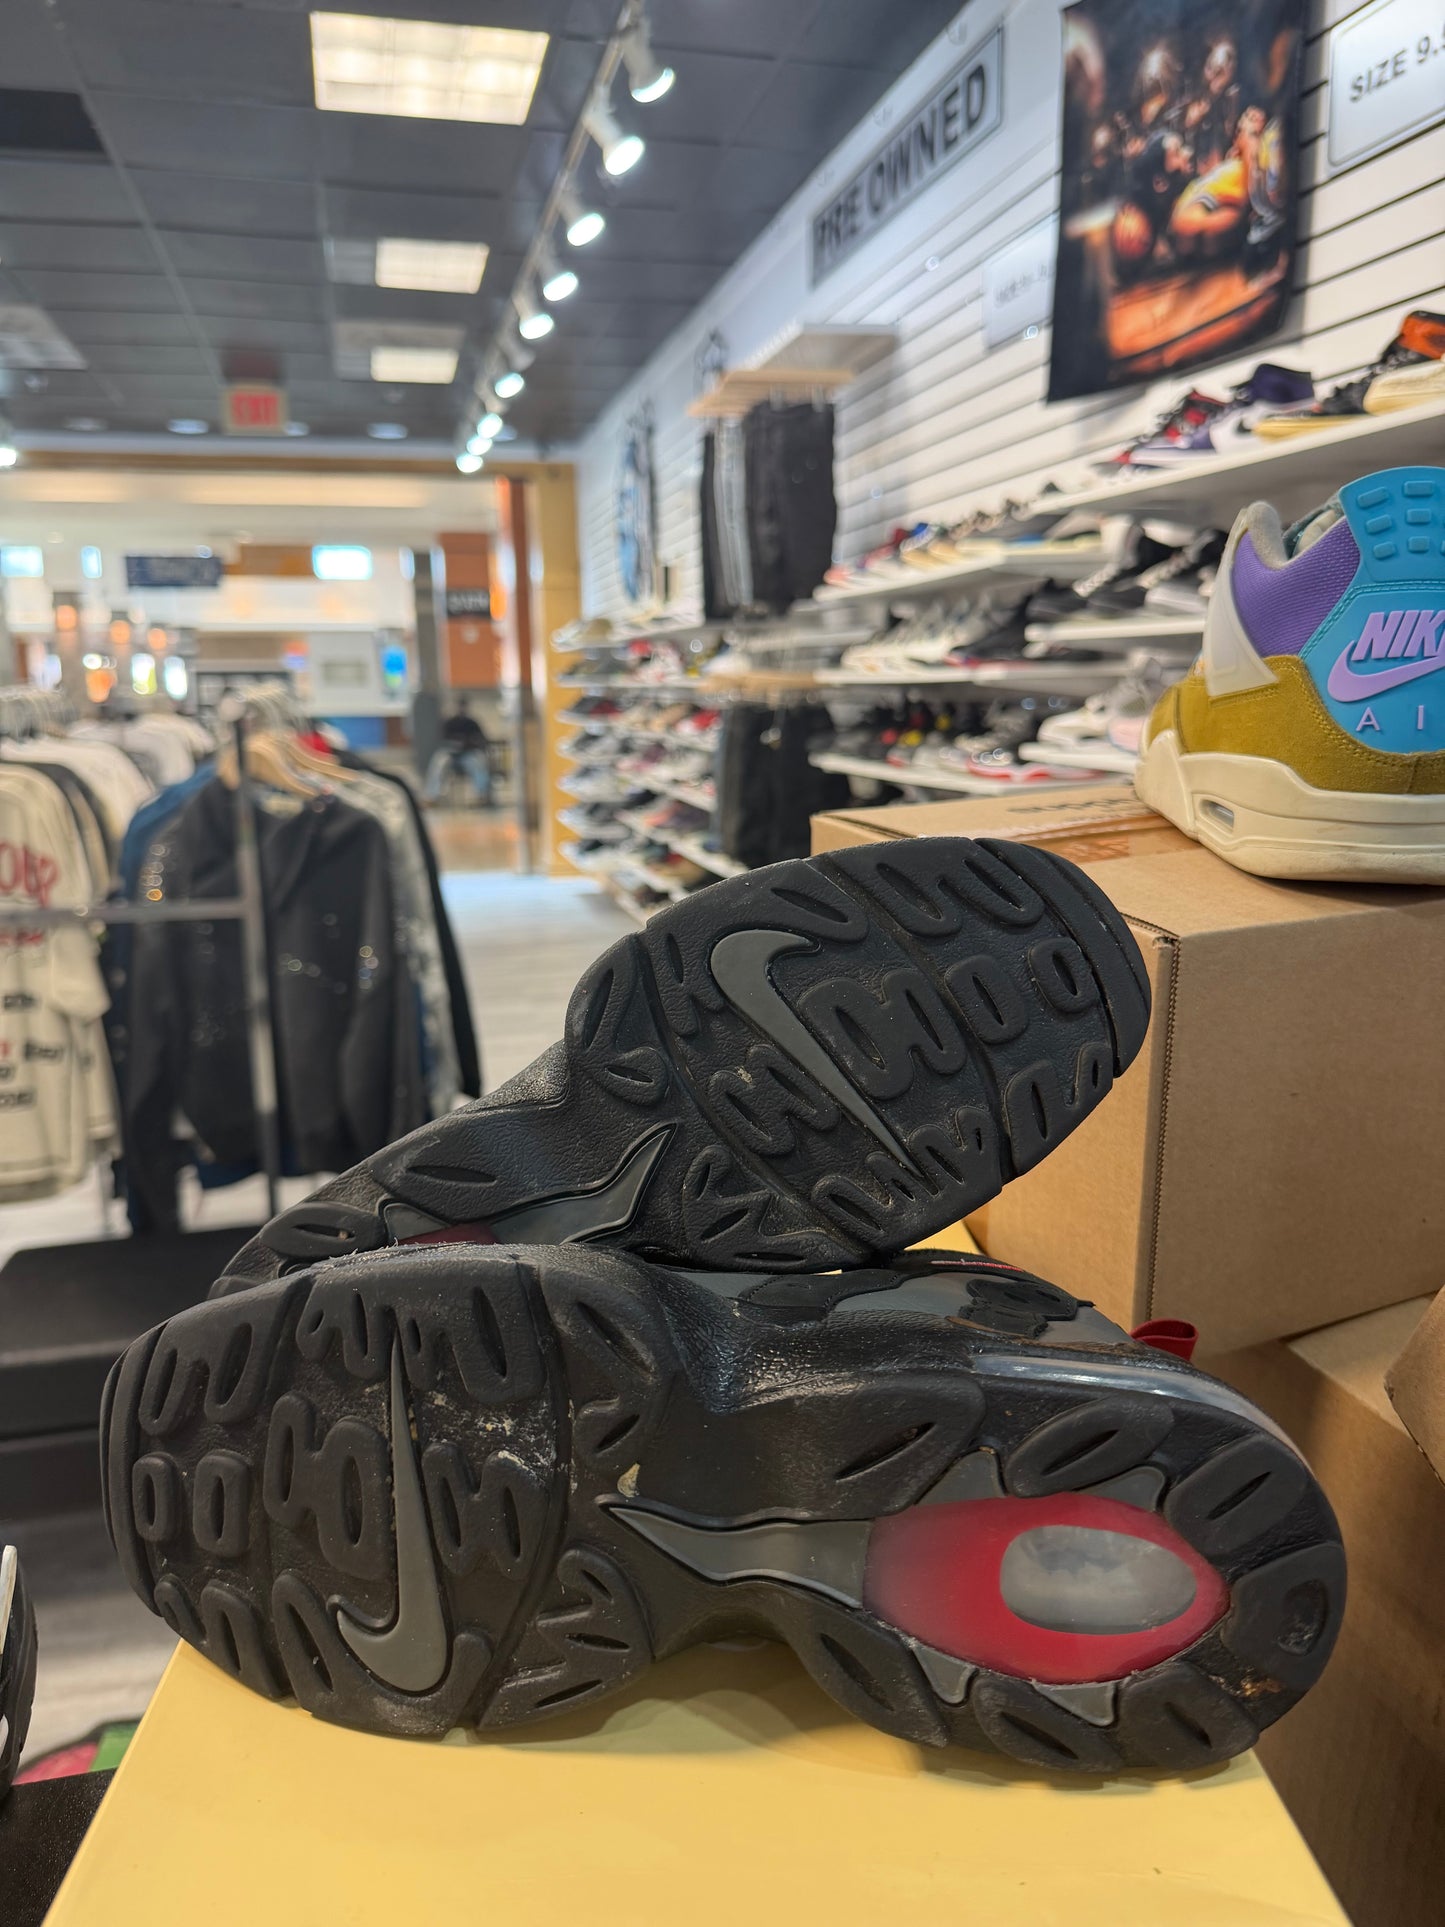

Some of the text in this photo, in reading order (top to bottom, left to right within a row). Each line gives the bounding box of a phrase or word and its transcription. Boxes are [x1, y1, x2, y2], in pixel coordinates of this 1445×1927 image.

[1350, 22, 1445, 103] SIZE 9.
[815, 64, 985, 258] PRE OWNED
[1351, 610, 1445, 661] NIK
